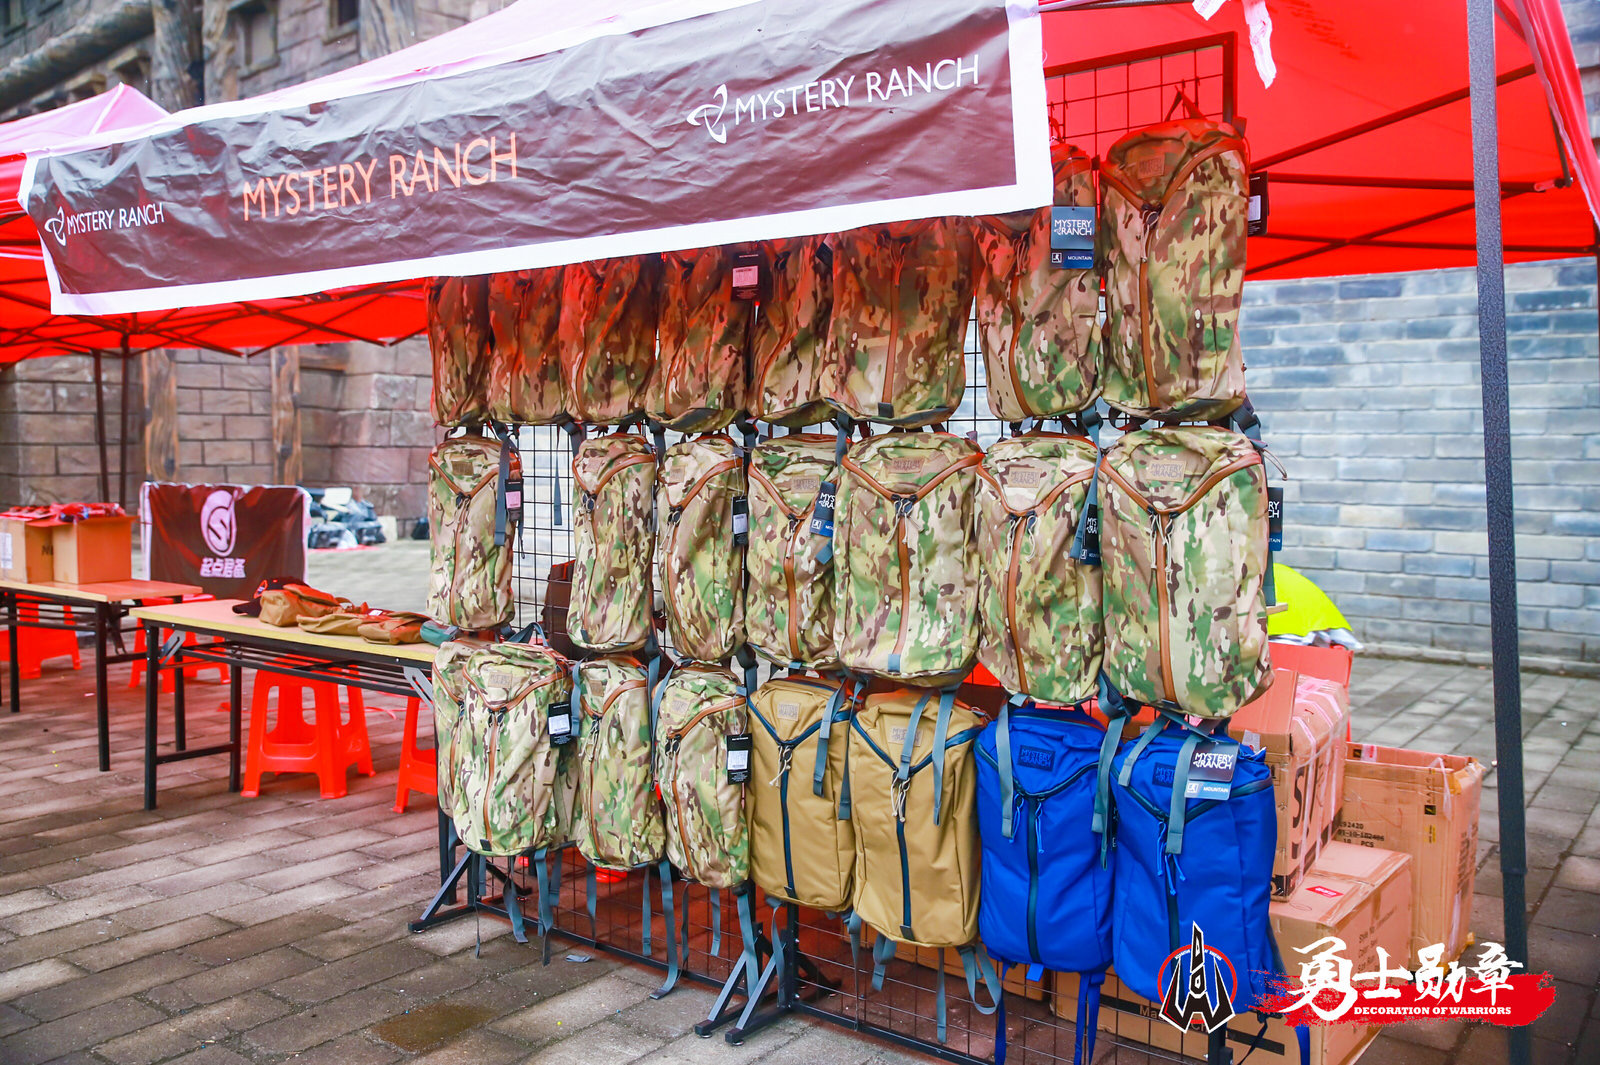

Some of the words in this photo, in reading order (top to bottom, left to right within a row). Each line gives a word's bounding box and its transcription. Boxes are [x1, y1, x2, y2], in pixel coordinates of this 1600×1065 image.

[735, 75, 855, 126] MYSTERY
[866, 54, 979, 103] RANCH
[242, 158, 378, 221] MYSTERY
[390, 131, 517, 199] RANCH
[66, 209, 115, 236] MYSTERY
[119, 202, 165, 229] RANCH
[1054, 219, 1092, 228] MYSTERY
[1061, 227, 1092, 236] RANCH
[1152, 463, 1183, 472] MYSTERY
[820, 492, 836, 503] MYS
[1268, 501, 1280, 510] RY
[1268, 509, 1280, 518] CH
[1195, 752, 1234, 761] MYSTERY
[1197, 760, 1233, 770] RANCH
[1156, 767, 1176, 777] MYST
[1360, 840, 1374, 848] PCS
